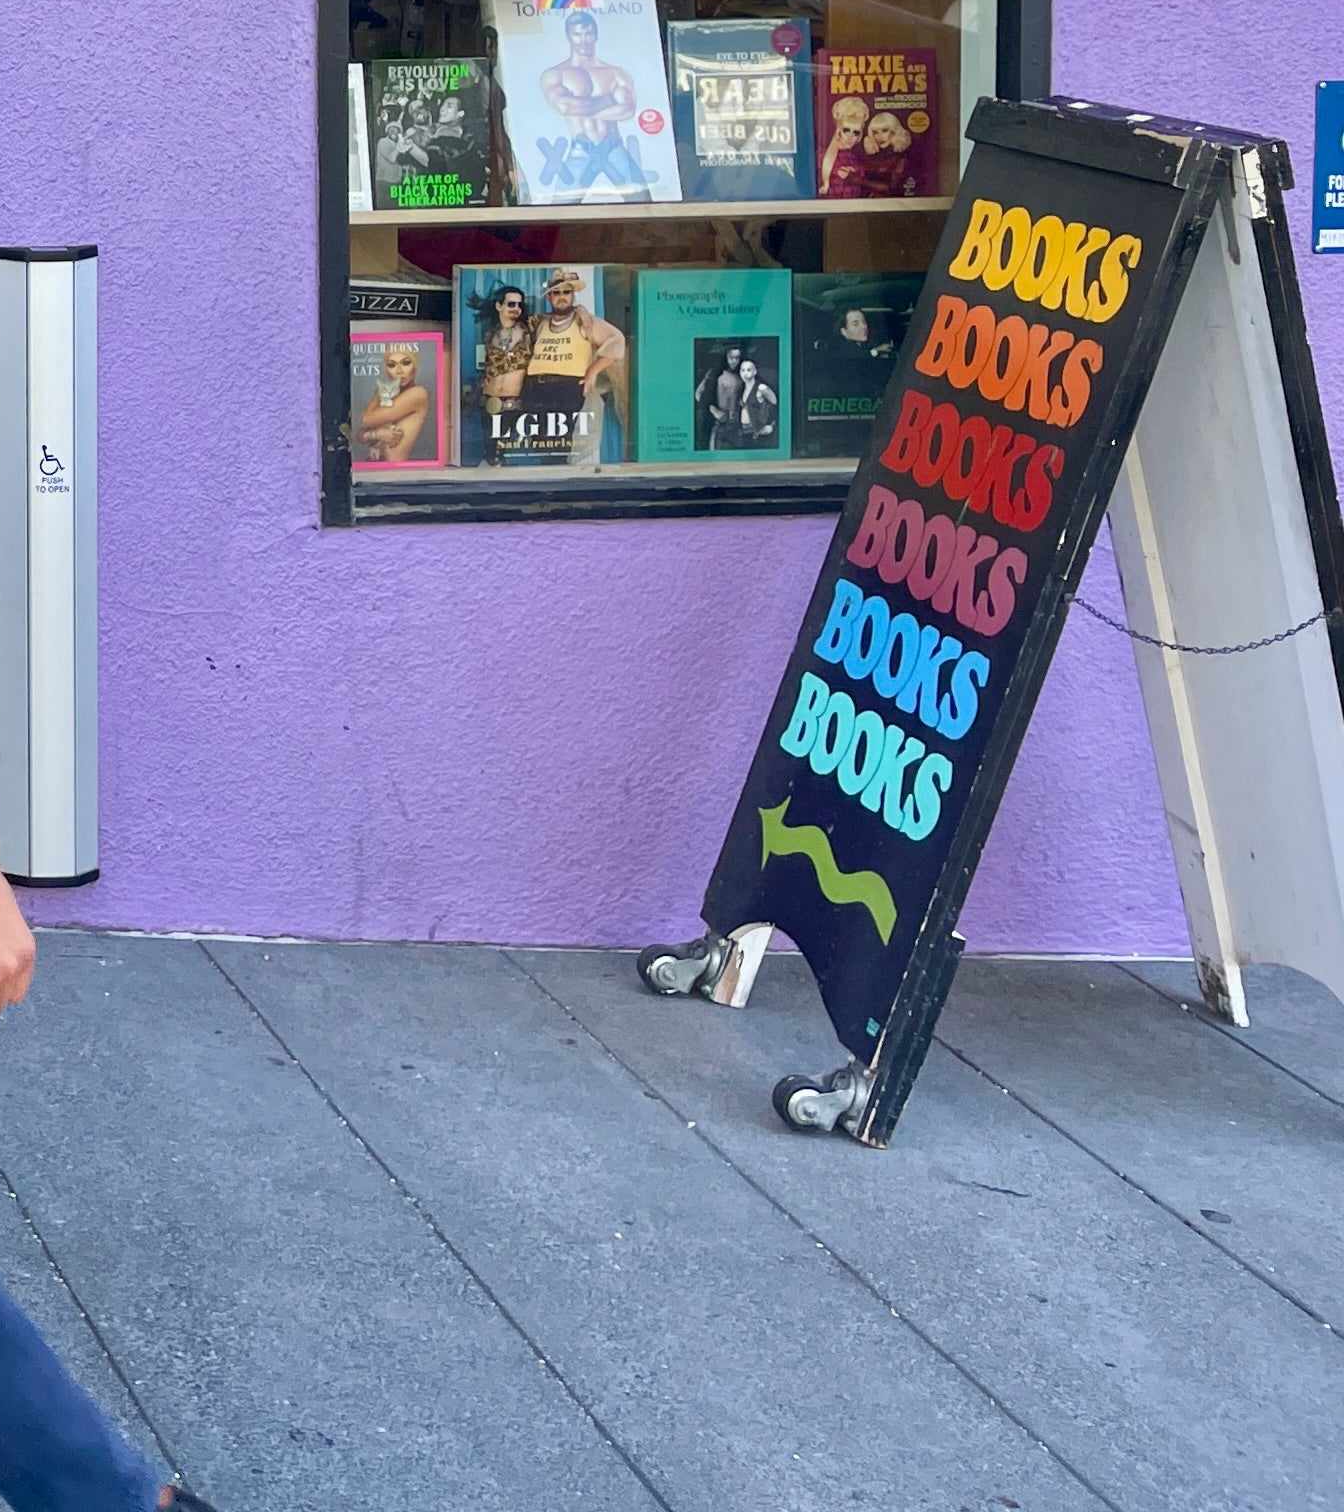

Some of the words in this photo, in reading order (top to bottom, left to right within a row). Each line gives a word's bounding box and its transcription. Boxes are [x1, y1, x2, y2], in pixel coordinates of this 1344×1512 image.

[735, 52, 749, 60] TO
[388, 64, 470, 79] REVOLUTION
[830, 55, 905, 75] TRIXIE
[399, 78, 415, 91] IS
[417, 78, 460, 91] LOVE
[830, 75, 928, 94] KATYA'S
[537, 134, 660, 186] XXL
[403, 176, 411, 185] A
[412, 175, 441, 185] YEAR
[443, 174, 459, 185] OF
[390, 186, 432, 198] BLACK
[435, 184, 472, 196] TRANS
[398, 194, 464, 206] LIBERATION
[1326, 192, 1344, 208] PLE
[949, 198, 1143, 323] BOOKS
[657, 289, 725, 304] Photography
[686, 305, 720, 317] Queer
[722, 304, 761, 316] History
[353, 343, 386, 354] QUEER
[390, 342, 420, 353] ICONS
[915, 294, 1103, 428] BOOKS
[353, 365, 381, 376] CATS
[808, 397, 883, 413] RENEGA
[491, 411, 595, 441] LGBT
[880, 390, 1065, 532] BOOKS
[847, 484, 1028, 636] BOOKS
[813, 578, 990, 740] BOOKS
[780, 671, 953, 840] BOOKS
